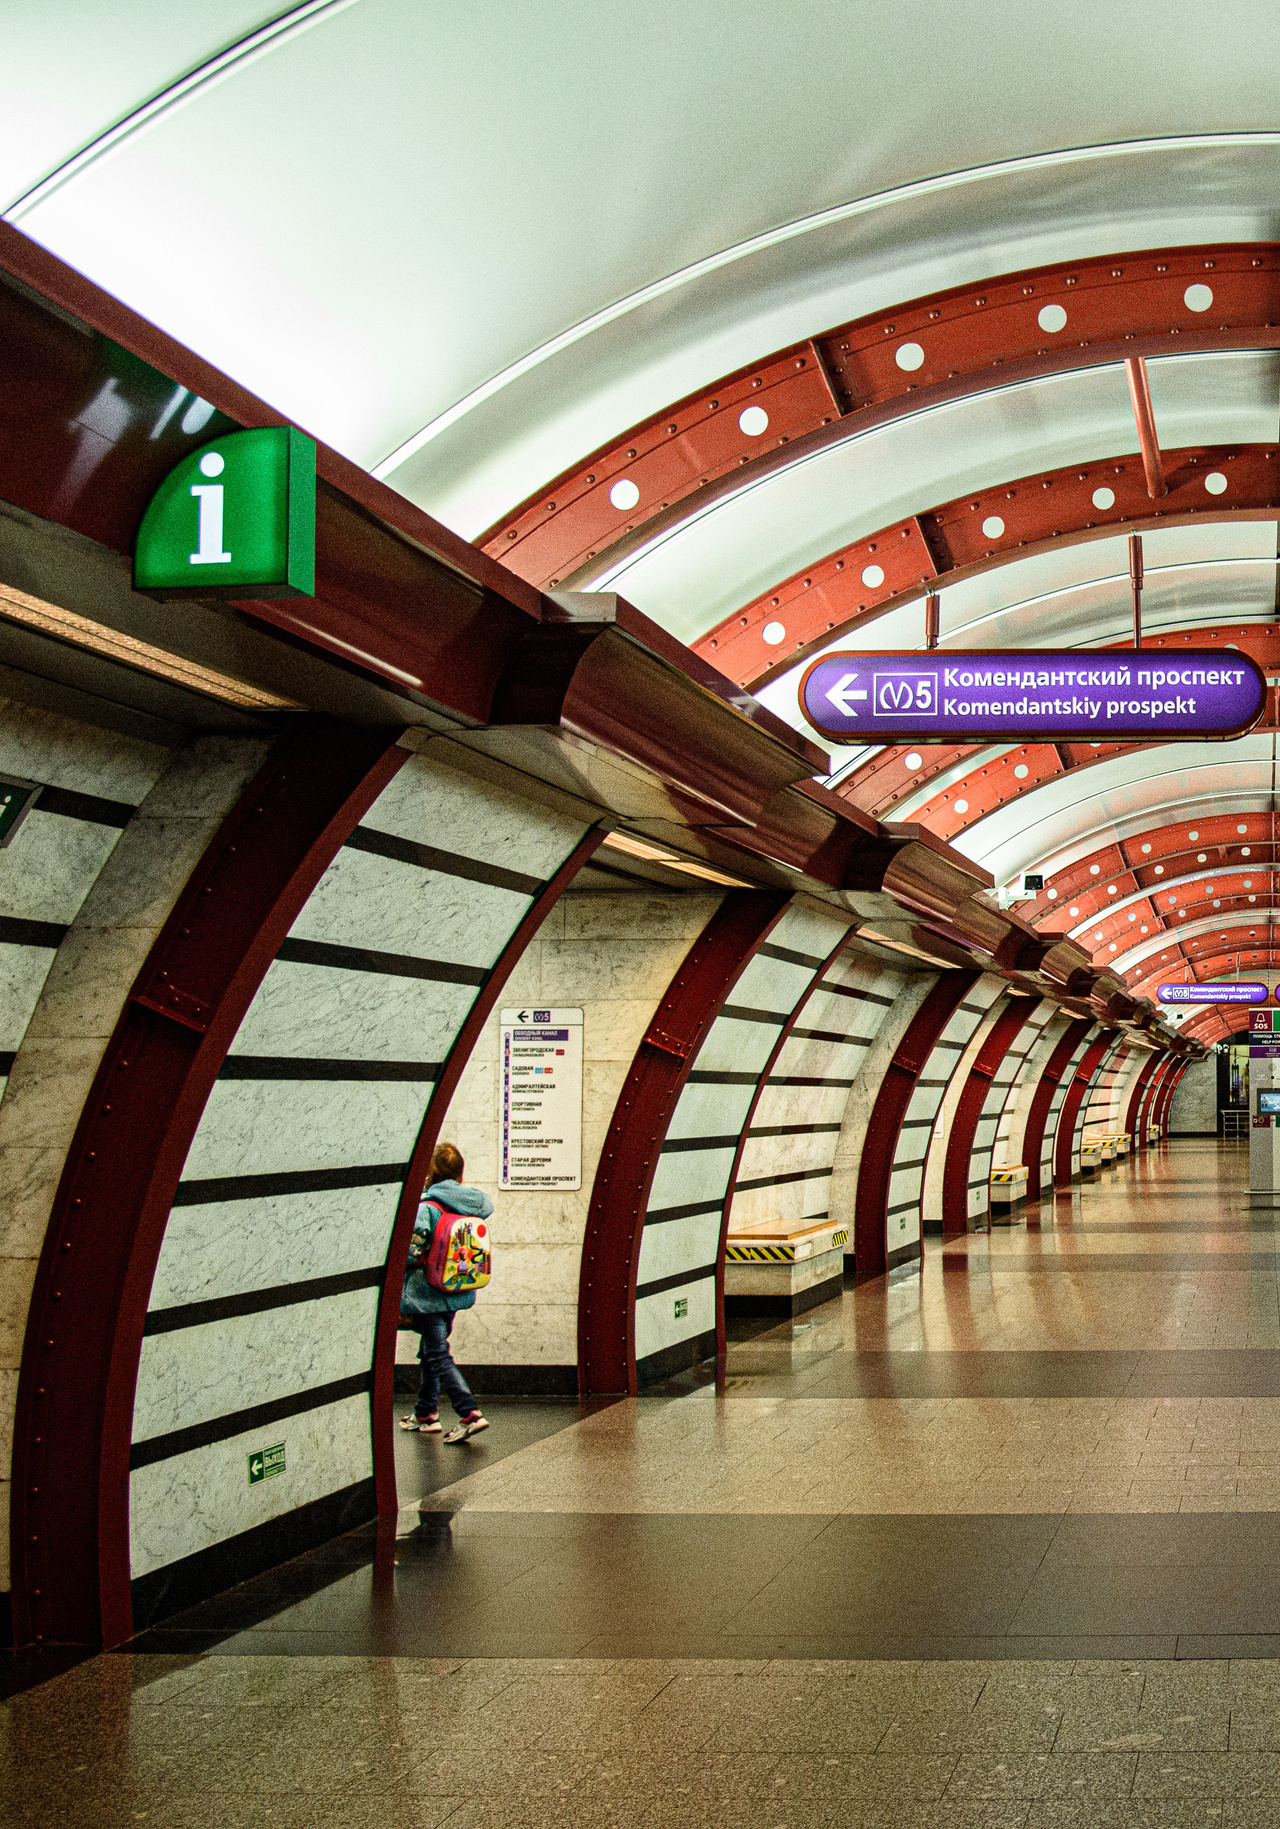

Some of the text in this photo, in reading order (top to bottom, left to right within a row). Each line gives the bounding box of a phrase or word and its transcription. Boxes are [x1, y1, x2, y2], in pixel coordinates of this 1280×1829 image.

[943, 666, 1130, 689] Комендантский
[1136, 670, 1244, 689] проспект
[943, 696, 1197, 719] Komendantskiy prospekt
